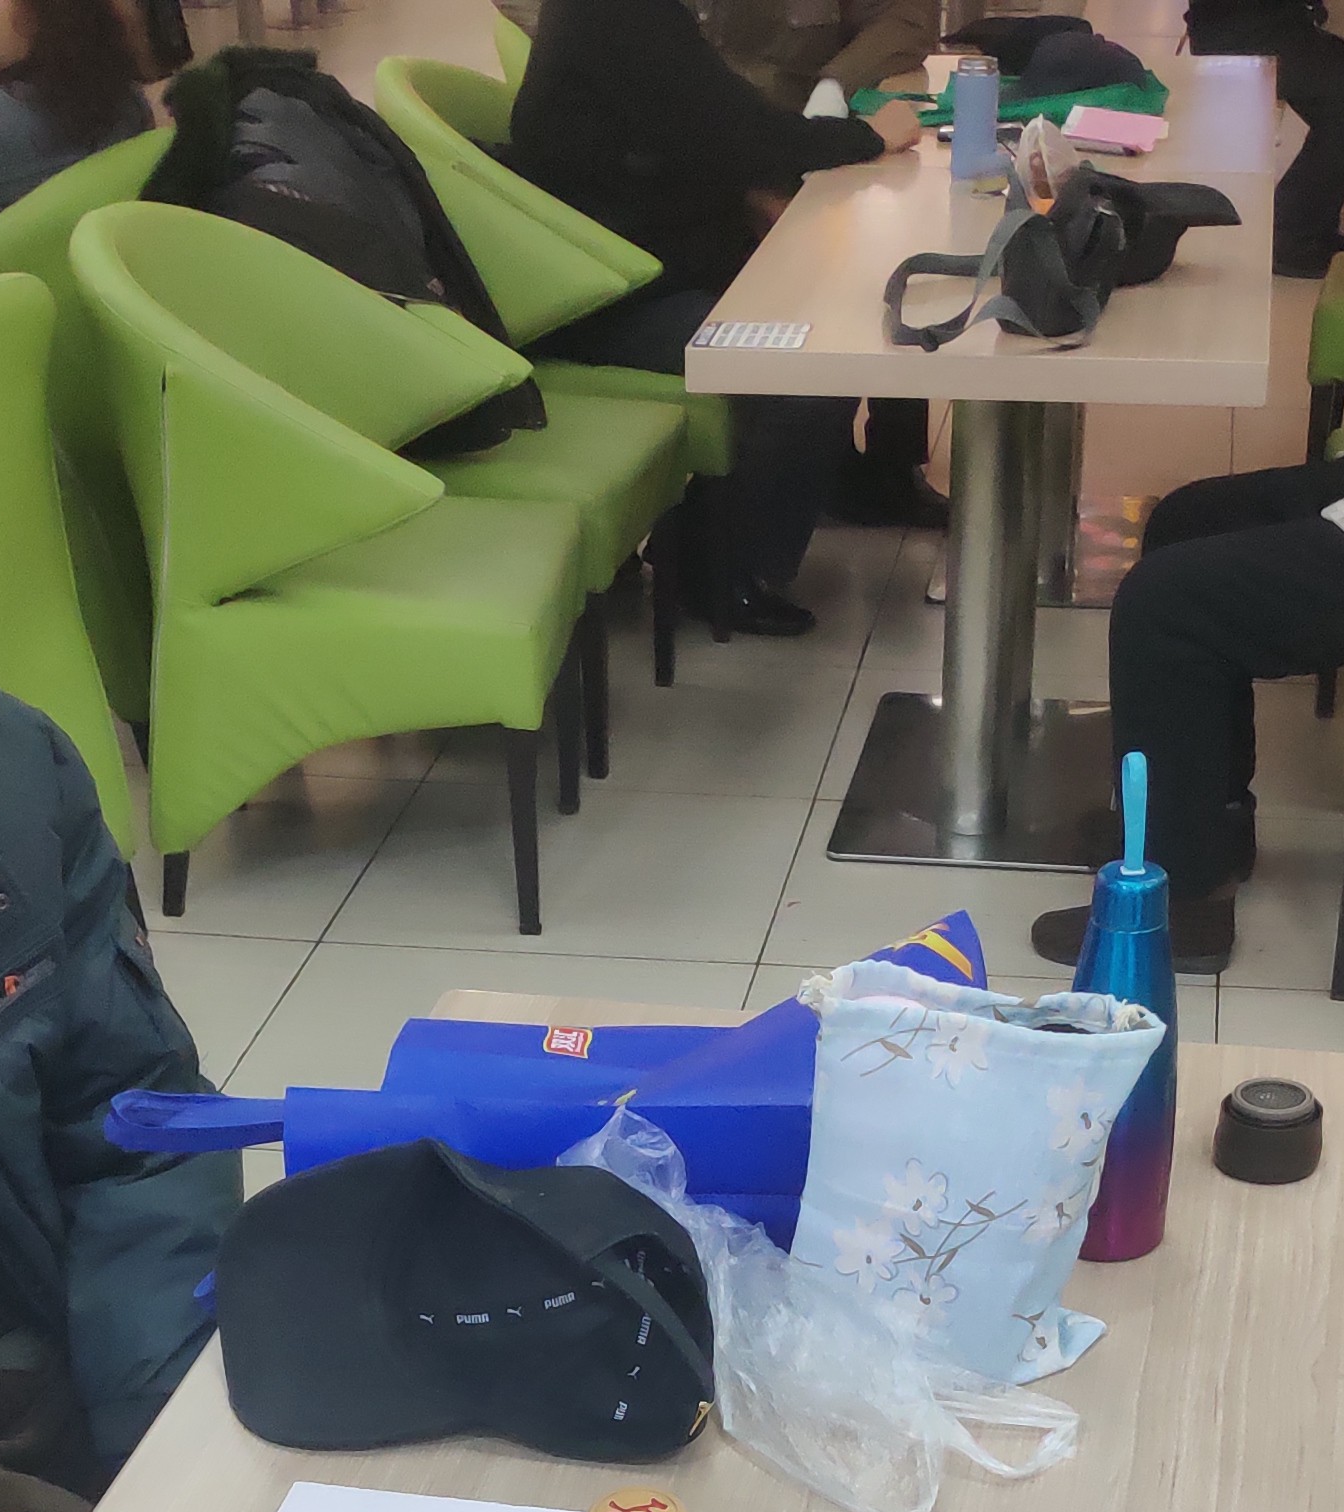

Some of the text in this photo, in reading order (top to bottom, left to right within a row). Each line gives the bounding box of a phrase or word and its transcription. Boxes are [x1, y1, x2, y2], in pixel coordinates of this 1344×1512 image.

[544, 1291, 575, 1310] PUMA
[456, 1313, 490, 1325] PUMA
[637, 1312, 652, 1345] UMA
